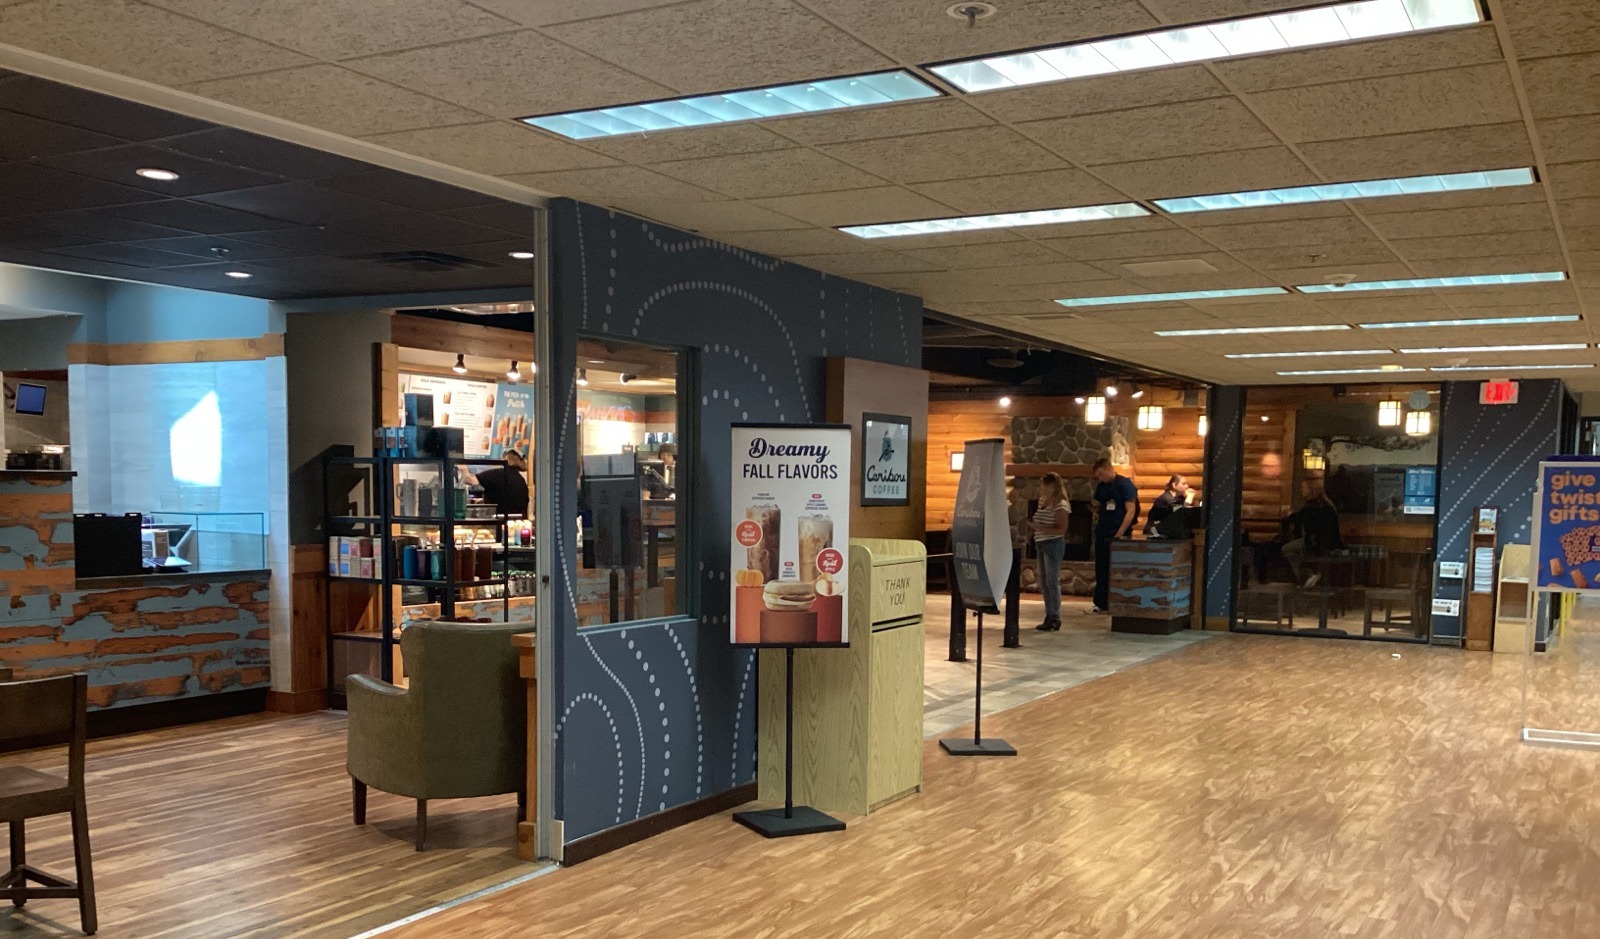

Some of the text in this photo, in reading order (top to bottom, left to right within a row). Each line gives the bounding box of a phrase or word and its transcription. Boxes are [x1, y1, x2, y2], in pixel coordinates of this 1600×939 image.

[748, 437, 830, 464] Dreamy
[743, 463, 838, 480] FALL FLAVORS
[866, 464, 907, 482] Caribou
[1550, 470, 1596, 490] give
[872, 484, 900, 495] COFFEE
[1549, 505, 1600, 525] gifts
[885, 576, 911, 591] THANK
[889, 592, 905, 606] YOU
